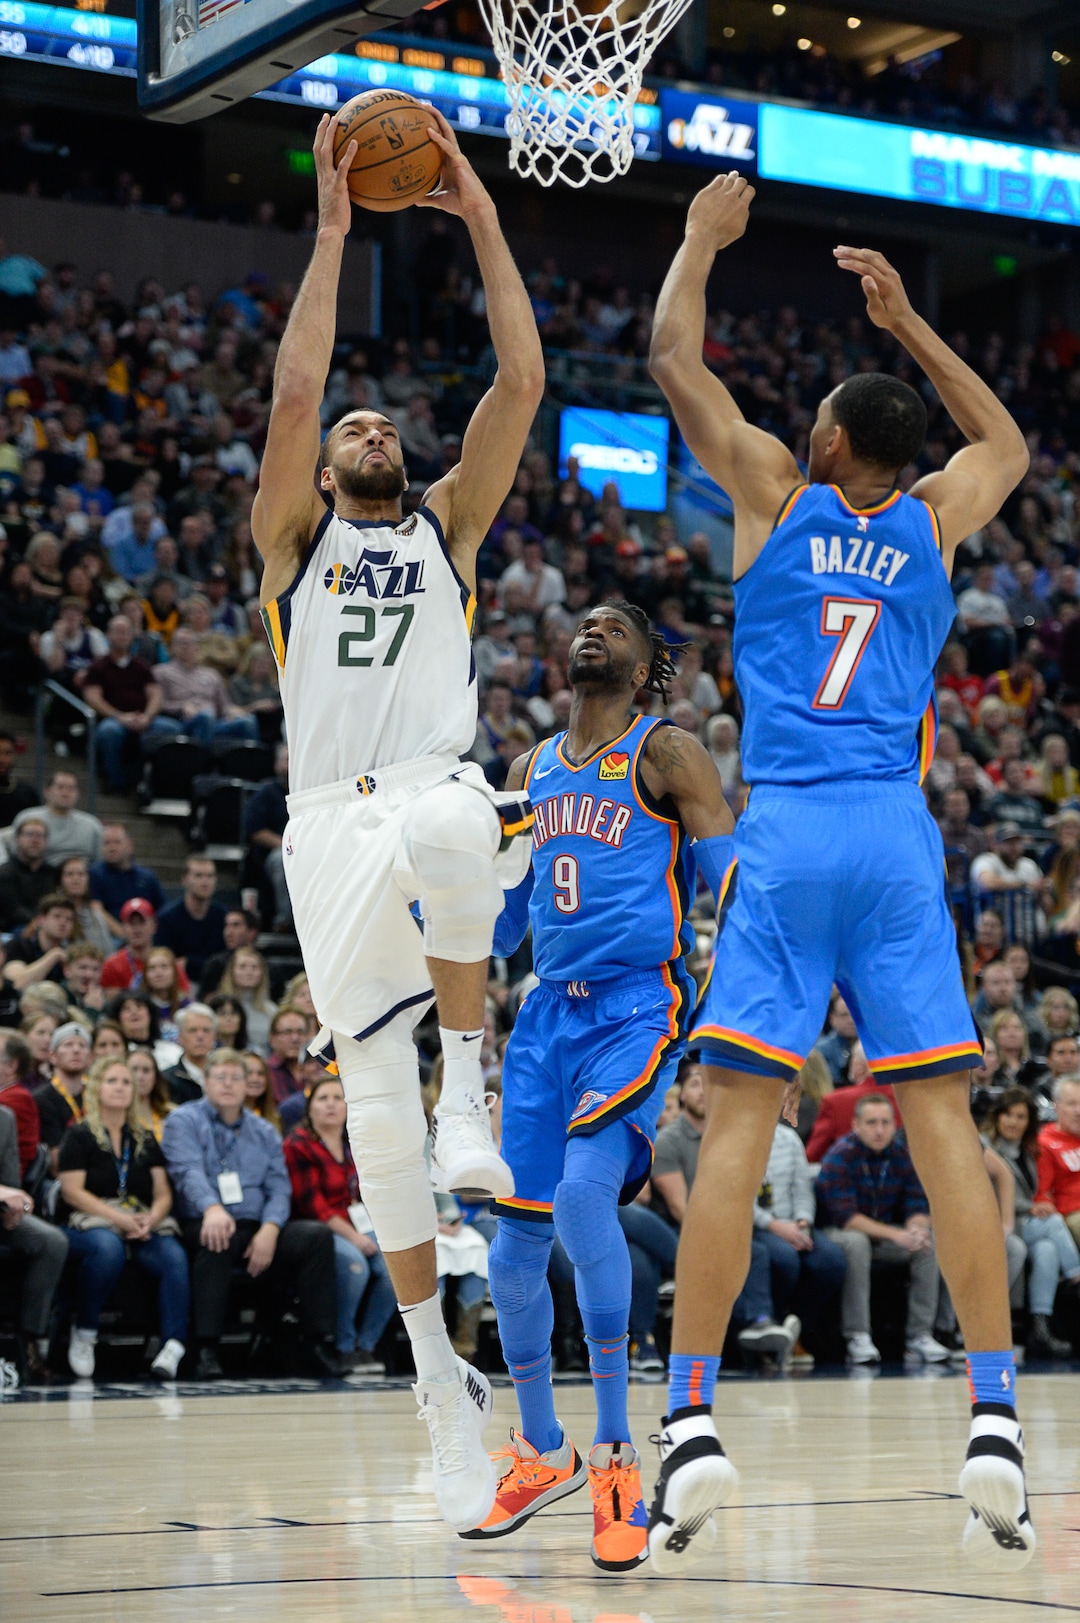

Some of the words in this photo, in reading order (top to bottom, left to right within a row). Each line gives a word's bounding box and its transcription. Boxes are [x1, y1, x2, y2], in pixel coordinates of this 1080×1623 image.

[910, 129, 1025, 172] MARK
[913, 158, 1077, 218] SUBA
[324, 547, 426, 600] JAZZ
[810, 536, 910, 587] BAZLEY
[337, 603, 415, 667] 27
[811, 596, 882, 711] 7
[552, 853, 580, 914] 9
[464, 1370, 487, 1413] NIKE
